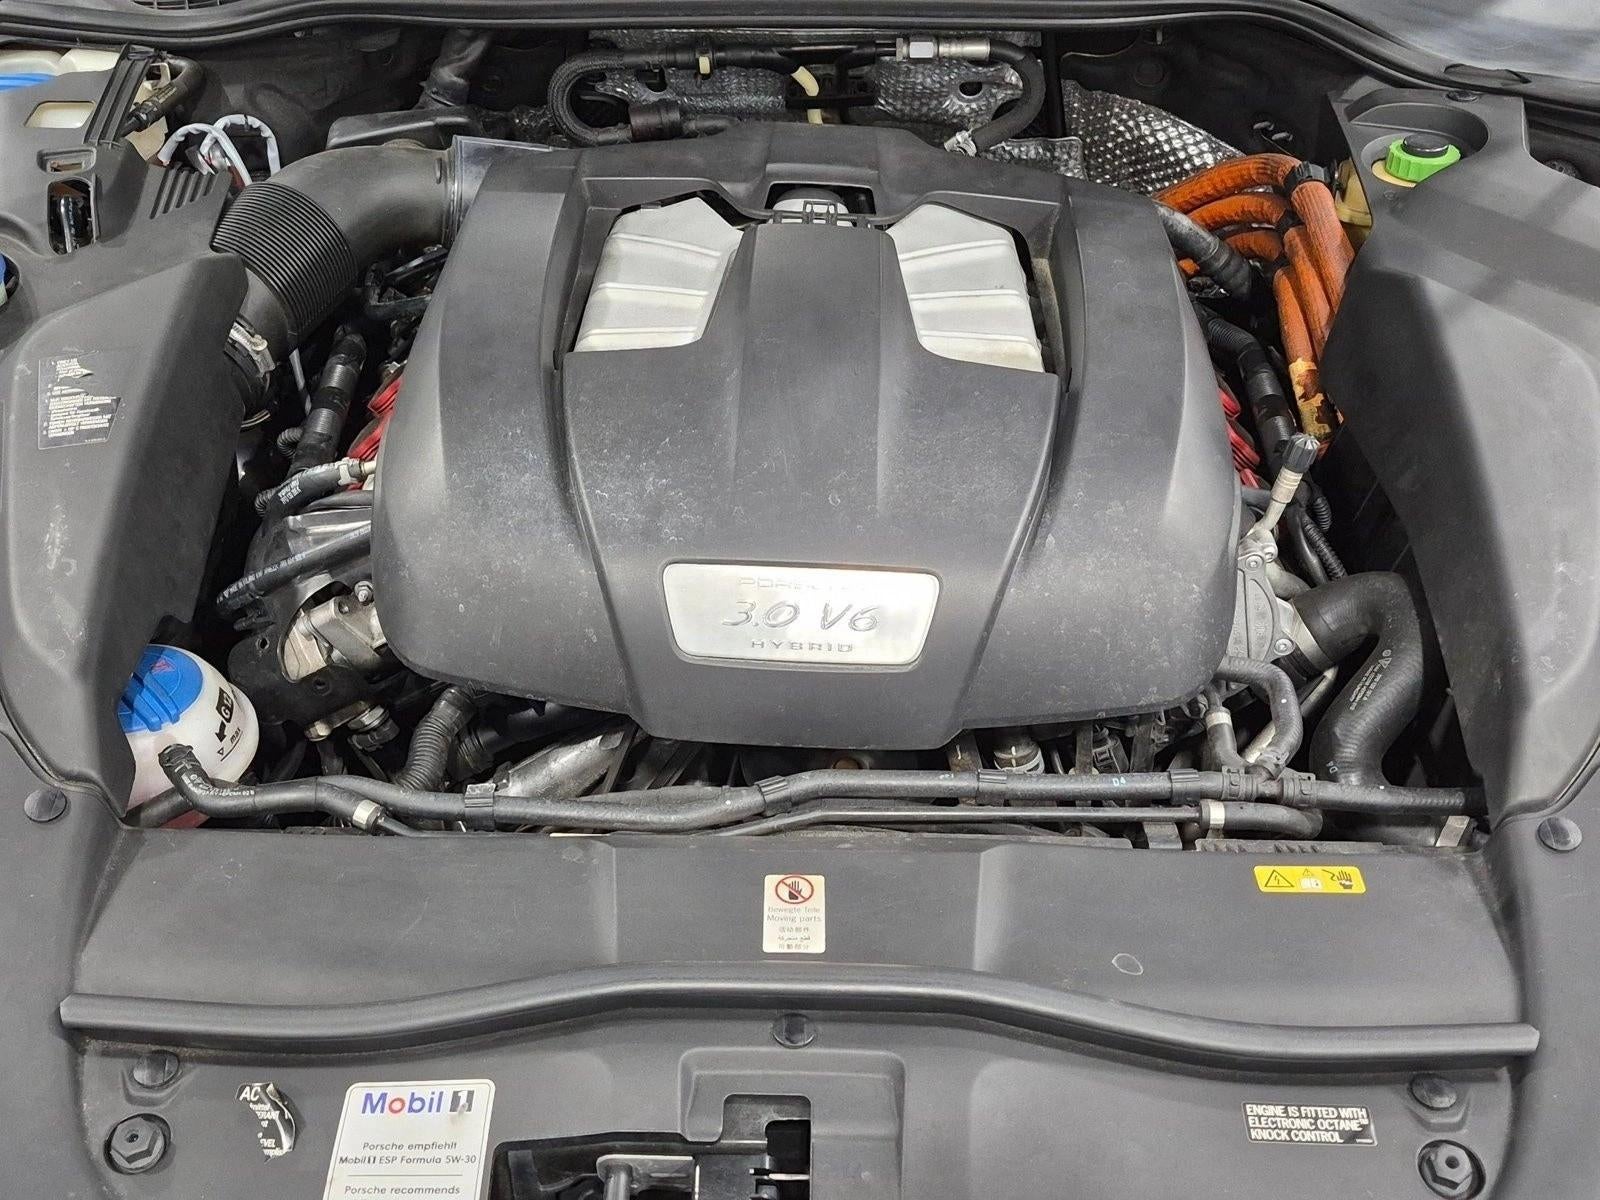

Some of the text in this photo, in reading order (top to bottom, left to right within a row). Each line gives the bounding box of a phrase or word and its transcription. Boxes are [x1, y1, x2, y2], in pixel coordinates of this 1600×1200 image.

[722, 600, 880, 632] 3.0 V6
[751, 641, 854, 653] HYBRID
[767, 914, 822, 923] Moving parts
[239, 1086, 260, 1101] AC
[361, 1091, 444, 1115] Mobil
[1245, 1104, 1368, 1119] ENGINE IS FITTED WITH
[1248, 1116, 1316, 1130] ELECTRONIC
[1250, 1128, 1345, 1143] KNOCK CONTROL
[363, 1142, 457, 1152] Porsche empfiehlt
[379, 1155, 398, 1165] ESP
[400, 1155, 442, 1165] Formula
[445, 1154, 477, 1164] 5W-30
[344, 1184, 460, 1195] Porsche recommends
